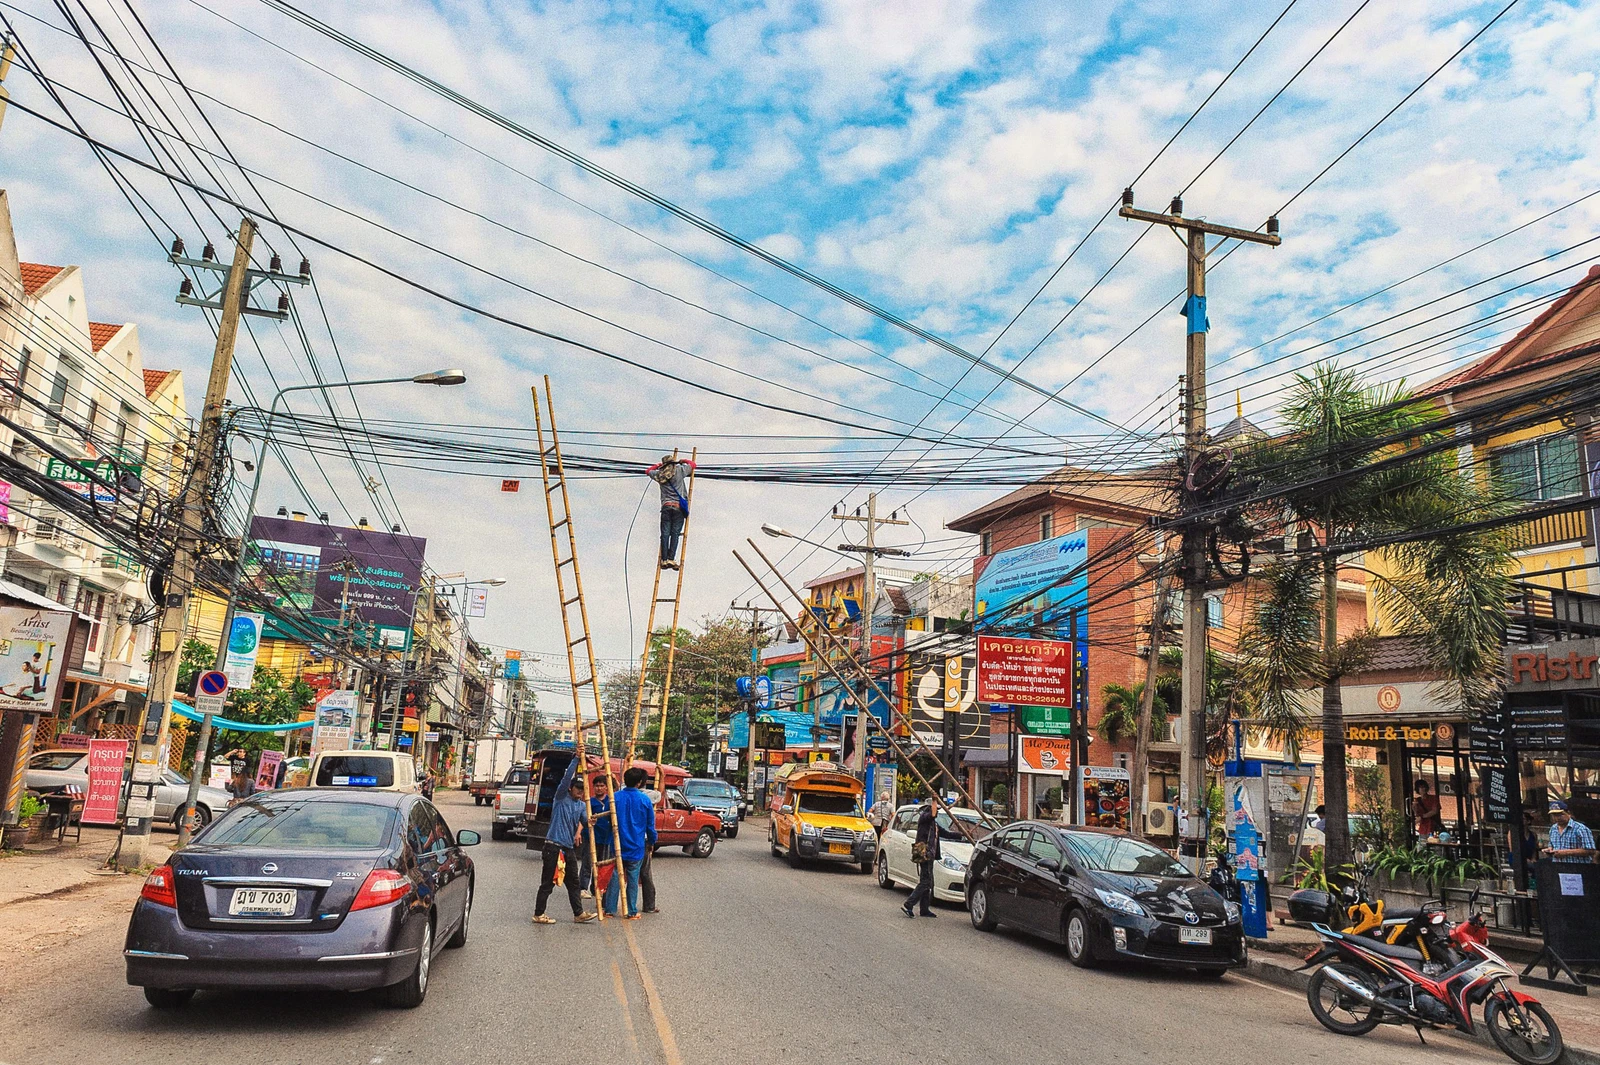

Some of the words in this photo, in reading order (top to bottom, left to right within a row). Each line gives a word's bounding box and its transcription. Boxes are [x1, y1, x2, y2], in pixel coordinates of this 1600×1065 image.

[19, 618, 50, 629] Artist
[1511, 651, 1600, 683] Ristr
[1349, 726, 1379, 740] Roti
[1384, 726, 1397, 741] &
[1401, 727, 1431, 740] Tea
[94, 749, 123, 762] กรุณา
[1489, 804, 1509, 812] Nimman
[1497, 812, 1506, 820] km
[261, 892, 291, 904] 7030
